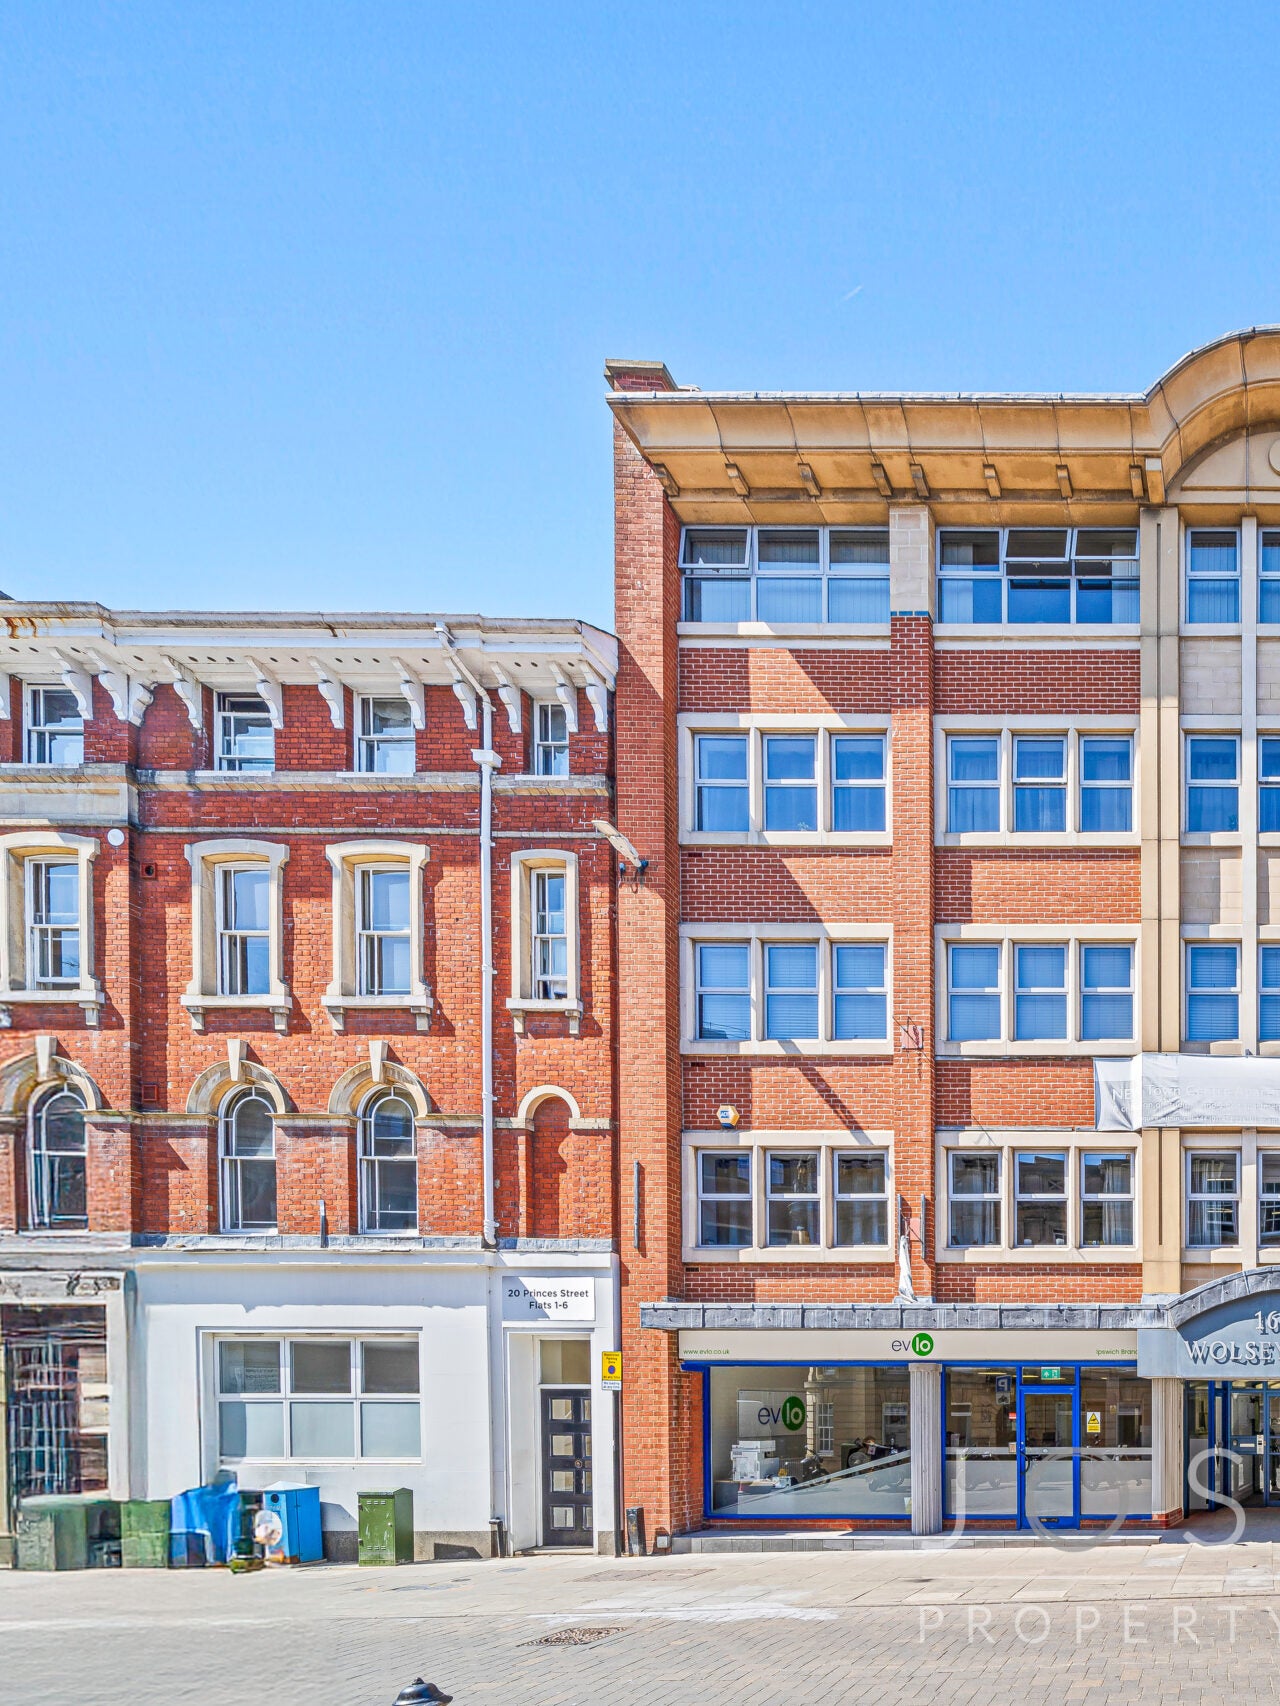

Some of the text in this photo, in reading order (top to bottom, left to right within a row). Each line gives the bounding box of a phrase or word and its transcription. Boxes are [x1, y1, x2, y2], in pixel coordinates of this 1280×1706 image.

[508, 1289, 589, 1298] 20 Princes Street
[529, 1301, 568, 1309] Flats 1-6
[1254, 1310, 1280, 1331] 16
[892, 1335, 932, 1353] evlo
[758, 1401, 804, 1426] evlo
